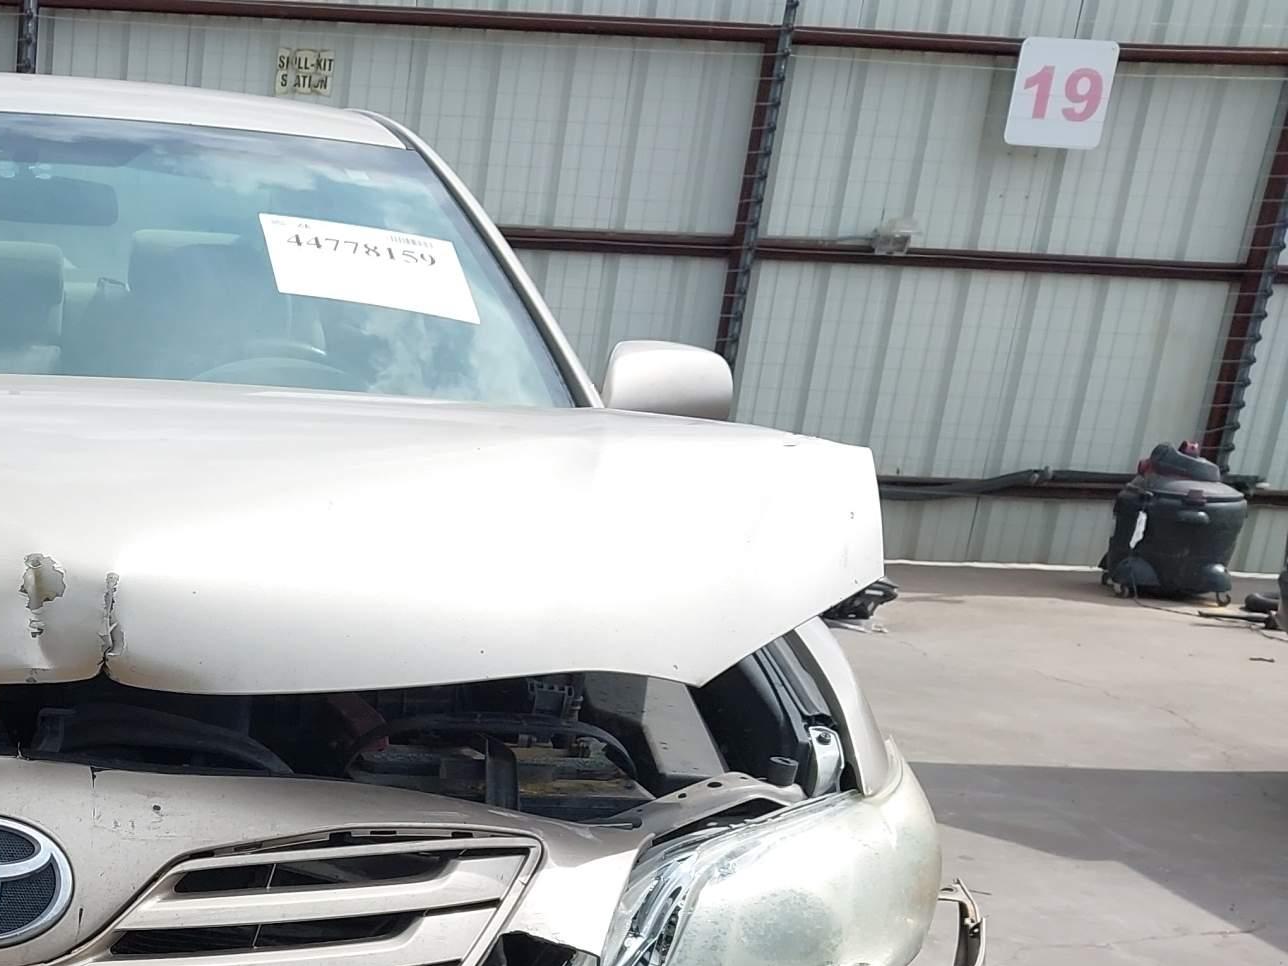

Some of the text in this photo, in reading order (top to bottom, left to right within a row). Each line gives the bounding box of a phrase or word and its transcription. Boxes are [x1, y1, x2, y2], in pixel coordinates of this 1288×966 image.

[279, 73, 328, 90] SATION
[1023, 65, 1104, 122] 19
[286, 233, 436, 266] 44778159
